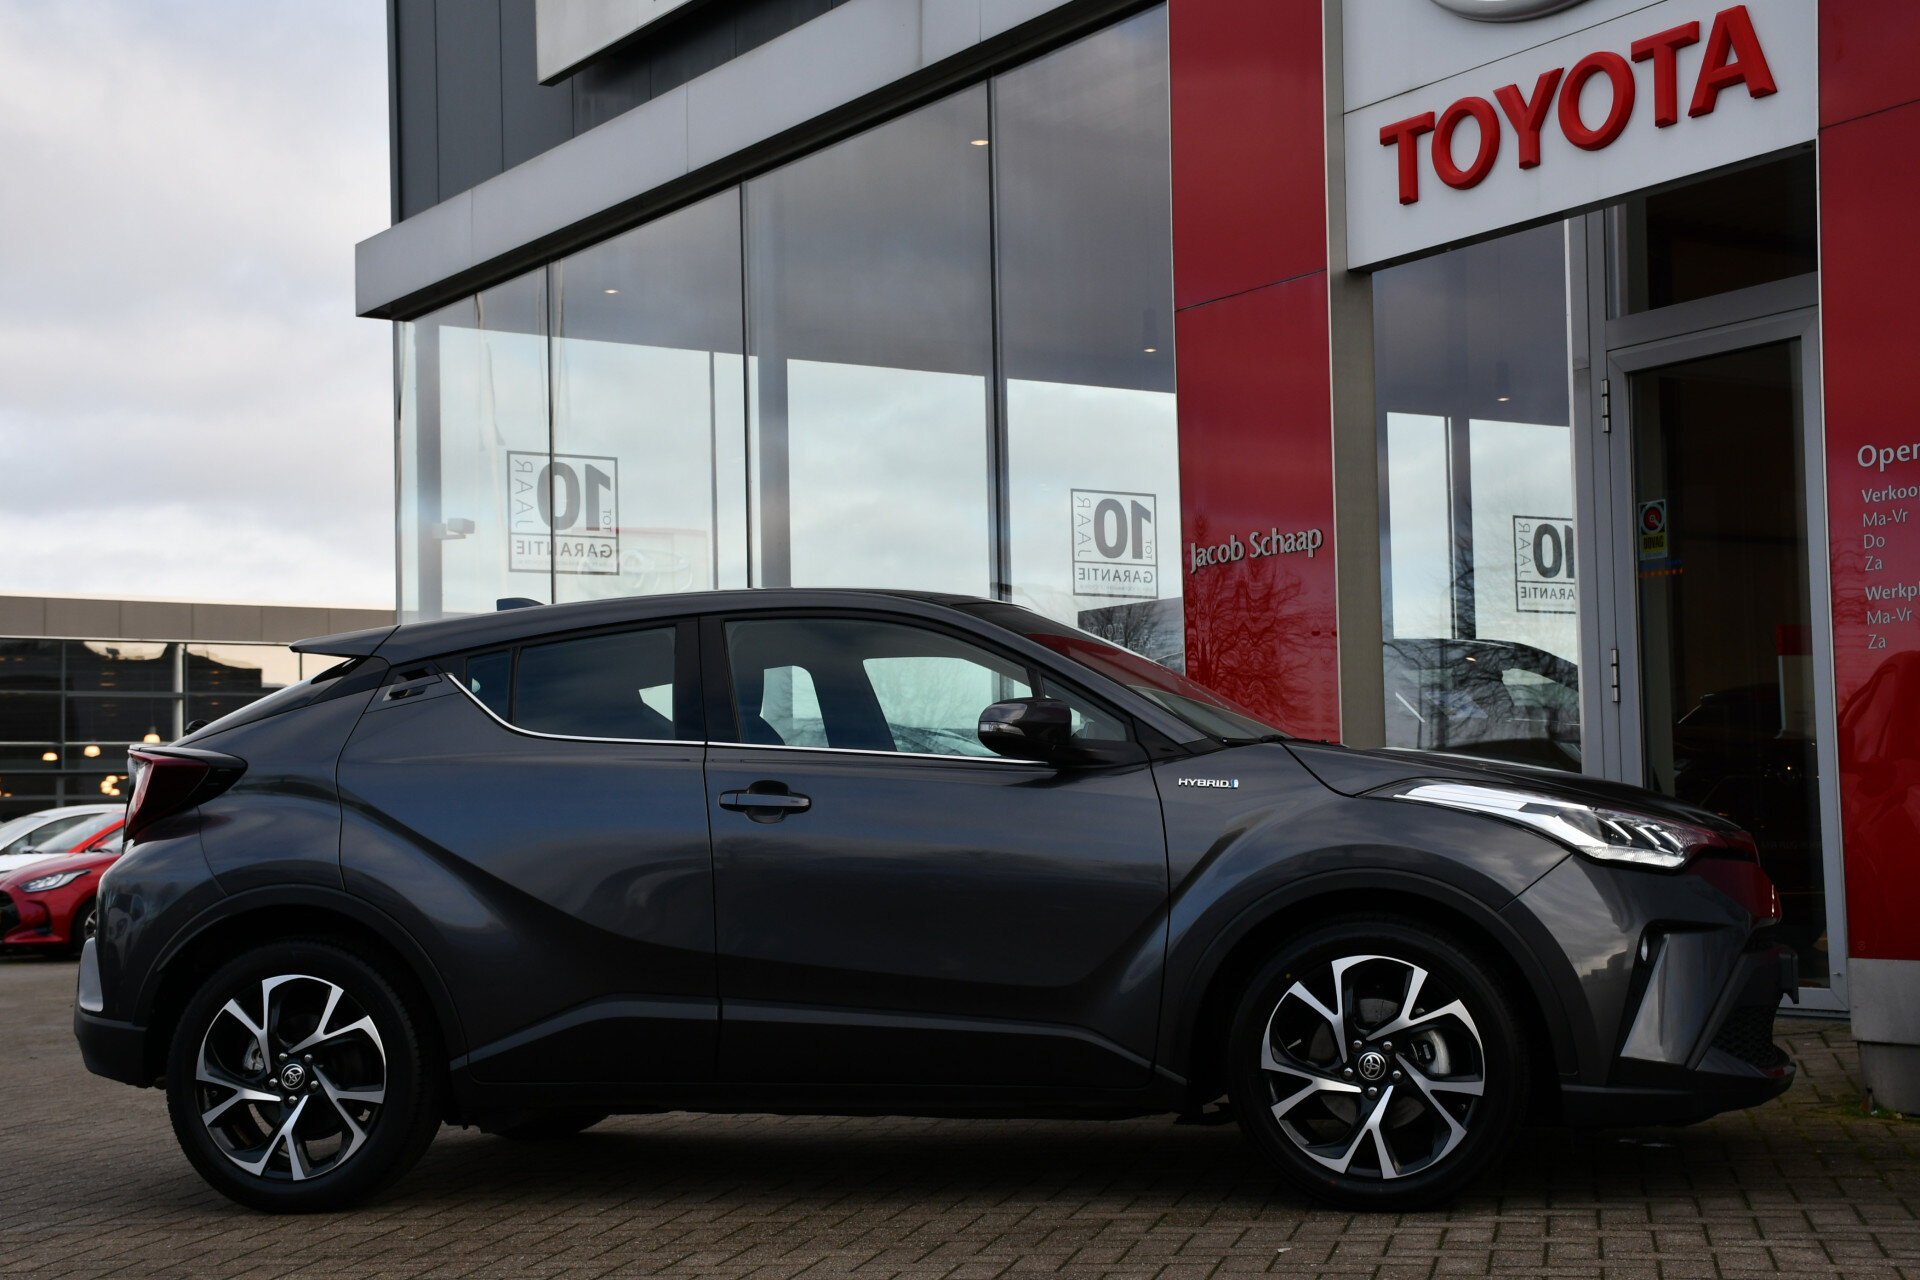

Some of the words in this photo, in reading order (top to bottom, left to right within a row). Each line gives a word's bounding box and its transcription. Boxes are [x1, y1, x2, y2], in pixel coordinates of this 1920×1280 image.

[1380, 5, 1777, 205] TOYOTA
[1861, 485, 1920, 503] Verkoo
[1862, 508, 1909, 527] Ma-Vr
[1864, 534, 1886, 549] Do
[1190, 534, 1245, 574] Jacob
[1249, 528, 1322, 558] Schaap
[1865, 555, 1883, 572] Za
[1867, 607, 1912, 626] Ma-Vr
[1868, 633, 1887, 650] Za
[1178, 778, 1230, 788] HYBRID
